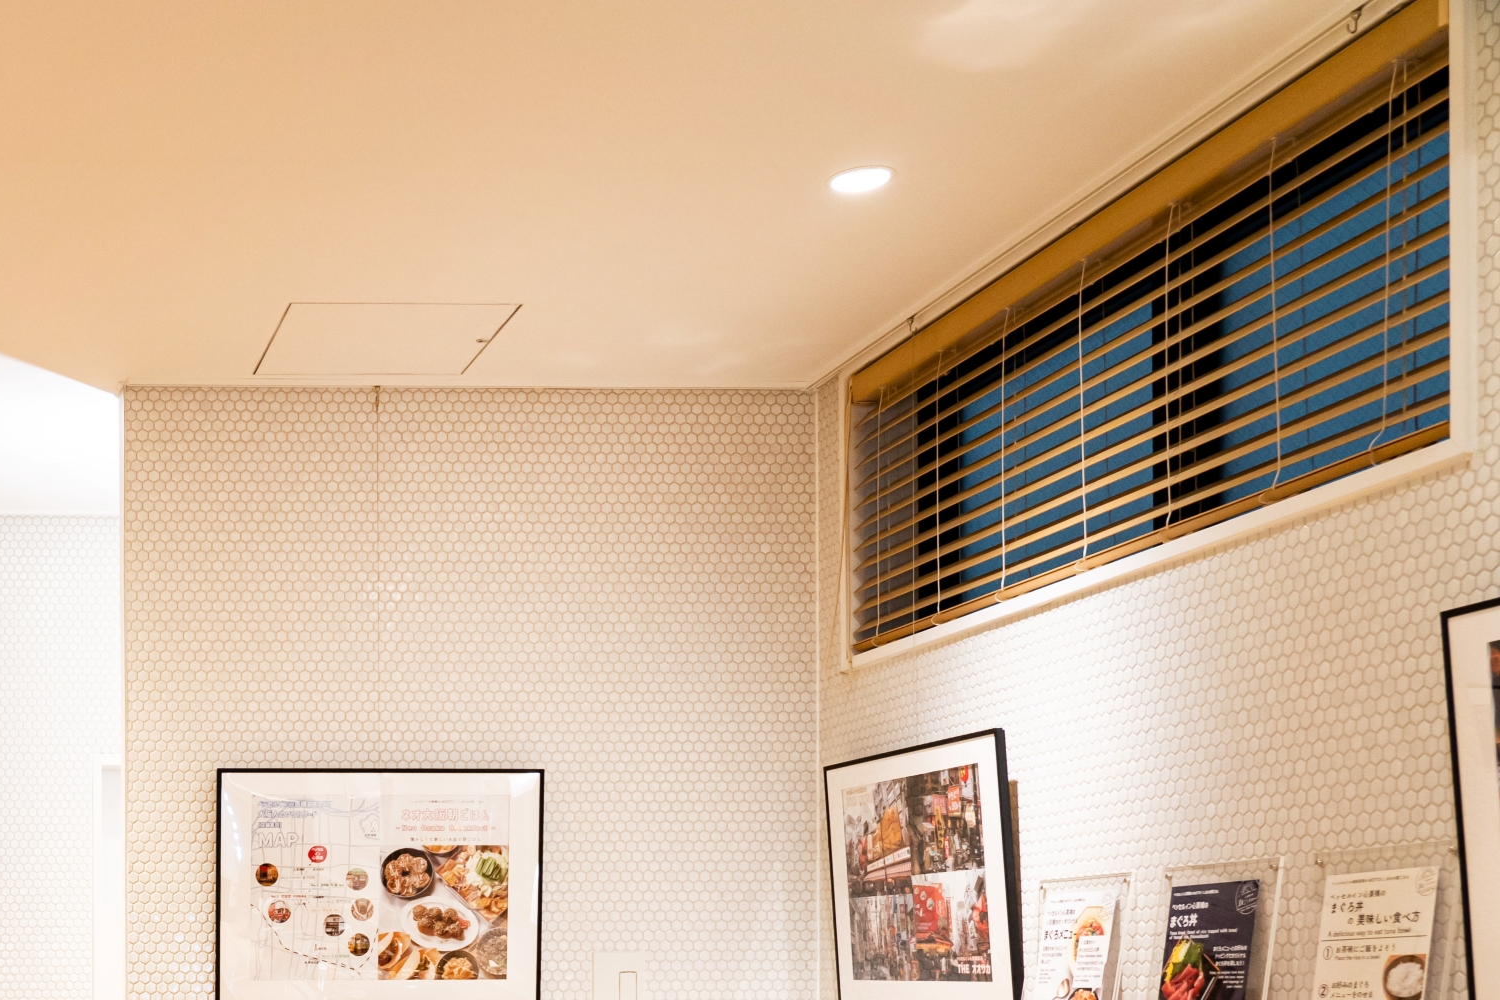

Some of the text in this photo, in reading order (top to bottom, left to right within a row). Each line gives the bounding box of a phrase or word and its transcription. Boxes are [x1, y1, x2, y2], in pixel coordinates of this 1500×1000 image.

[401, 808, 490, 822] ネオ大阪朝ごはん
[258, 831, 299, 848] MAP
[1331, 901, 1364, 914] まぐろ丼
[1169, 913, 1198, 929] まぐろ丼
[957, 963, 991, 975] THE オオサカ
[1330, 991, 1373, 999] メニューをのせる
